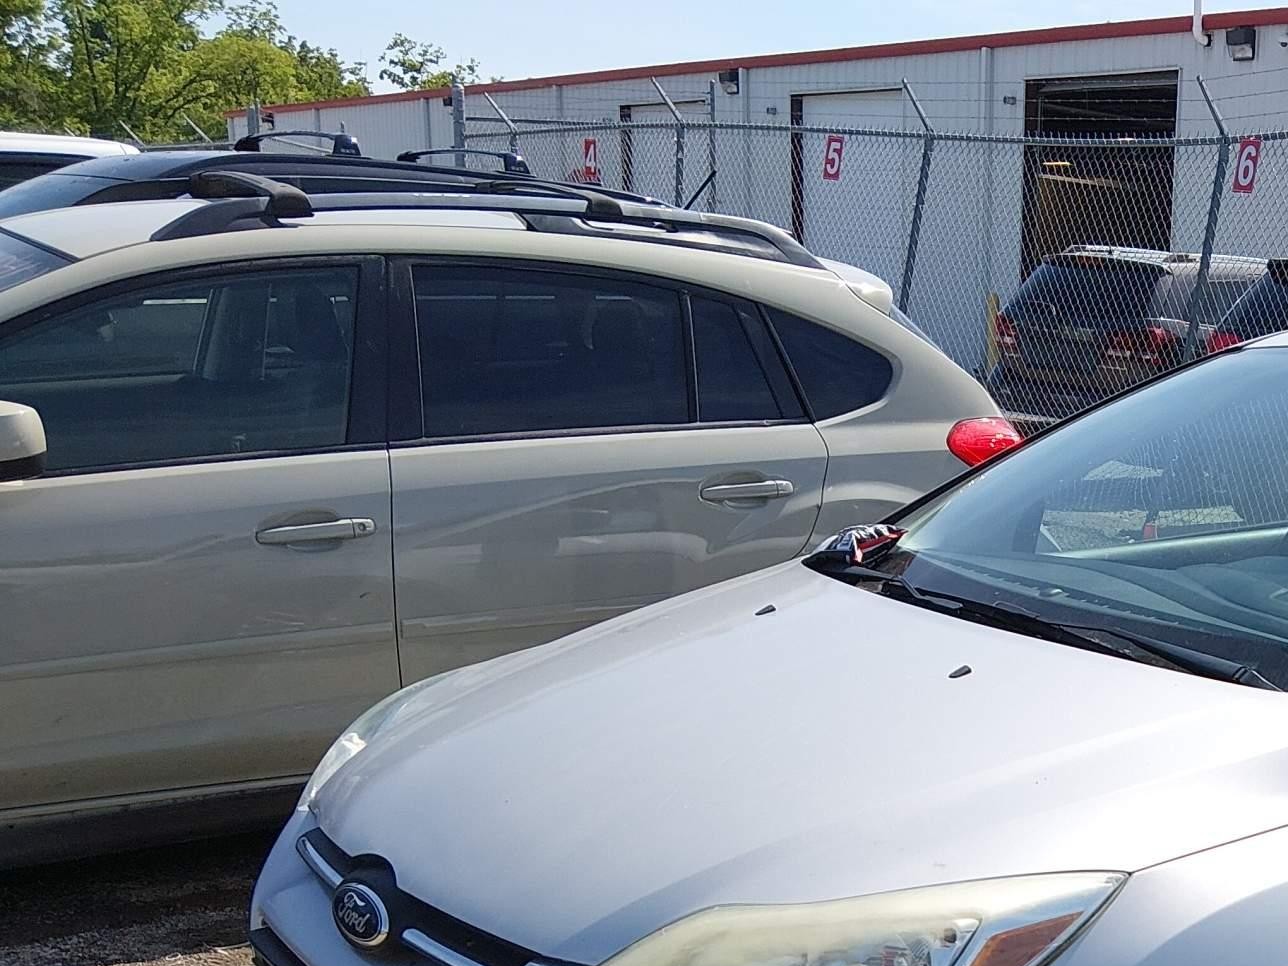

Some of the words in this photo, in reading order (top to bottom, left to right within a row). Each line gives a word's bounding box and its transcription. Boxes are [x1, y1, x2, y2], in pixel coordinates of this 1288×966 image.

[585, 143, 596, 173] 4
[826, 141, 841, 175] 5
[1237, 144, 1257, 187] 6
[338, 891, 371, 934] Ford
